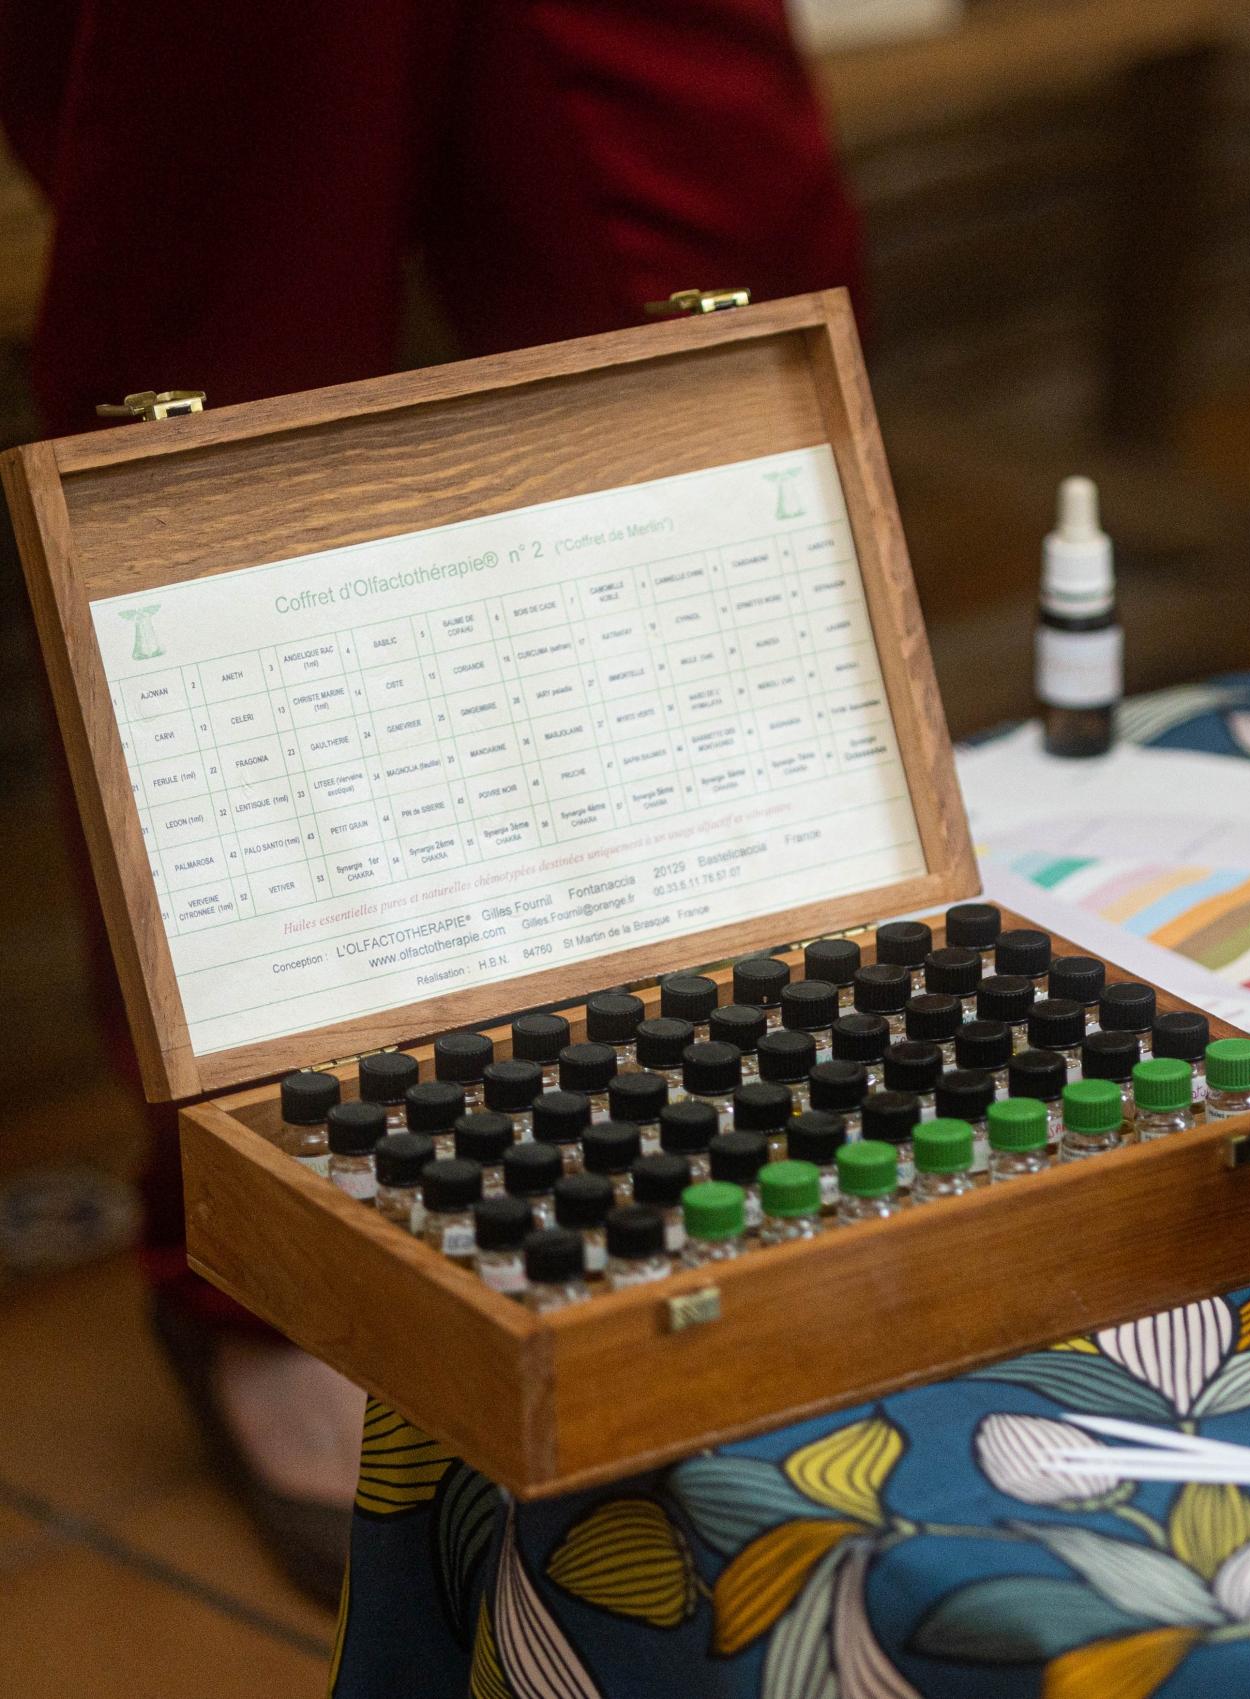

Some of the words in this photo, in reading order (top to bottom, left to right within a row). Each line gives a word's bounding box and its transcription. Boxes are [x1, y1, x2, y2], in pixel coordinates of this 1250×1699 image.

[274, 586, 336, 614] Coffret
[530, 540, 544, 559] 2
[283, 647, 319, 663] ANGELIQUE
[268, 663, 274, 672] 3
[302, 659, 319, 670] (1ml)
[221, 670, 243, 682] ANETH
[190, 680, 196, 689] 2
[140, 687, 168, 700] AJOWAN
[292, 692, 320, 706] CHRISTE
[319, 687, 344, 699] MARINE
[276, 705, 286, 714] 13
[229, 712, 254, 725] CELERI
[199, 723, 207, 731] 12
[153, 730, 175, 742] CARVI
[309, 734, 349, 751] GAULTHERIE
[286, 747, 295, 756] 23
[209, 765, 217, 774] 22
[152, 774, 178, 787] FERULE
[180, 770, 196, 782] (1ml)
[296, 789, 305, 798] 33
[234, 797, 271, 813] LENTISQUE
[272, 794, 289, 805] (1ml)
[218, 808, 227, 817] 32
[164, 818, 188, 829] LEDON
[187, 813, 204, 825] (1ml)
[329, 823, 347, 835] PETIT
[348, 819, 368, 830] GRAIN
[306, 831, 315, 840] 43
[243, 844, 262, 855] PALO
[261, 839, 284, 851] SANTO
[283, 836, 300, 847] (1ml)
[228, 850, 237, 858] 42
[174, 856, 214, 871] PALMAROSA
[315, 874, 325, 883] 53
[267, 880, 295, 894] VETIVER
[187, 893, 219, 908] VERVEINE
[239, 892, 248, 901] 52
[178, 905, 215, 921] CITRONNEE
[271, 954, 323, 974] Conception
[480, 905, 513, 921] Gilles
[513, 893, 553, 913] Fournil
[567, 875, 636, 900] Fontanaccia
[652, 860, 686, 879] 20129
[283, 918, 316, 935] Huiles
[318, 903, 378, 926] essentielles
[409, 893, 418, 903] et
[367, 925, 506, 968] www.olfactotherapie.com
[415, 967, 465, 985] Réalisation
[574, 931, 606, 945] Martin
[607, 927, 620, 938] de
